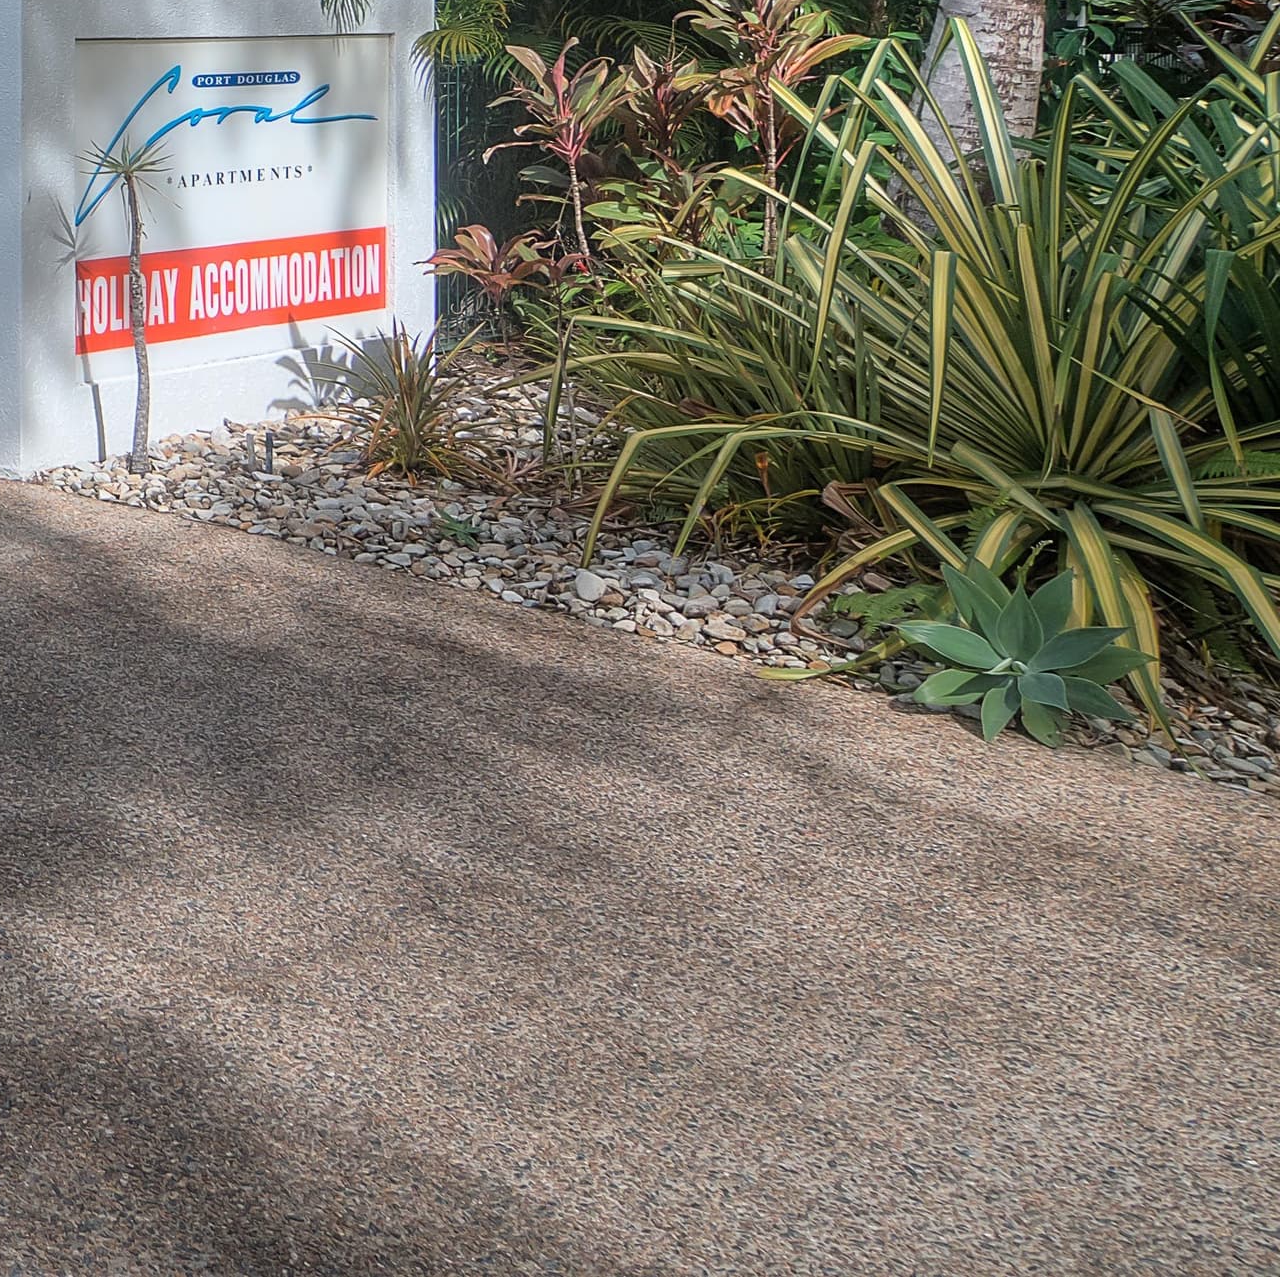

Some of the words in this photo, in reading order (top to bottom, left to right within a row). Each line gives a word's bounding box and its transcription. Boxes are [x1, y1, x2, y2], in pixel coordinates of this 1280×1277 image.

[197, 75, 231, 86] PORT
[237, 73, 297, 84] DOUGLAS
[74, 64, 378, 226] Coral
[178, 165, 303, 188] APARTMENTS
[189, 244, 380, 320] ACCOMMODATION
